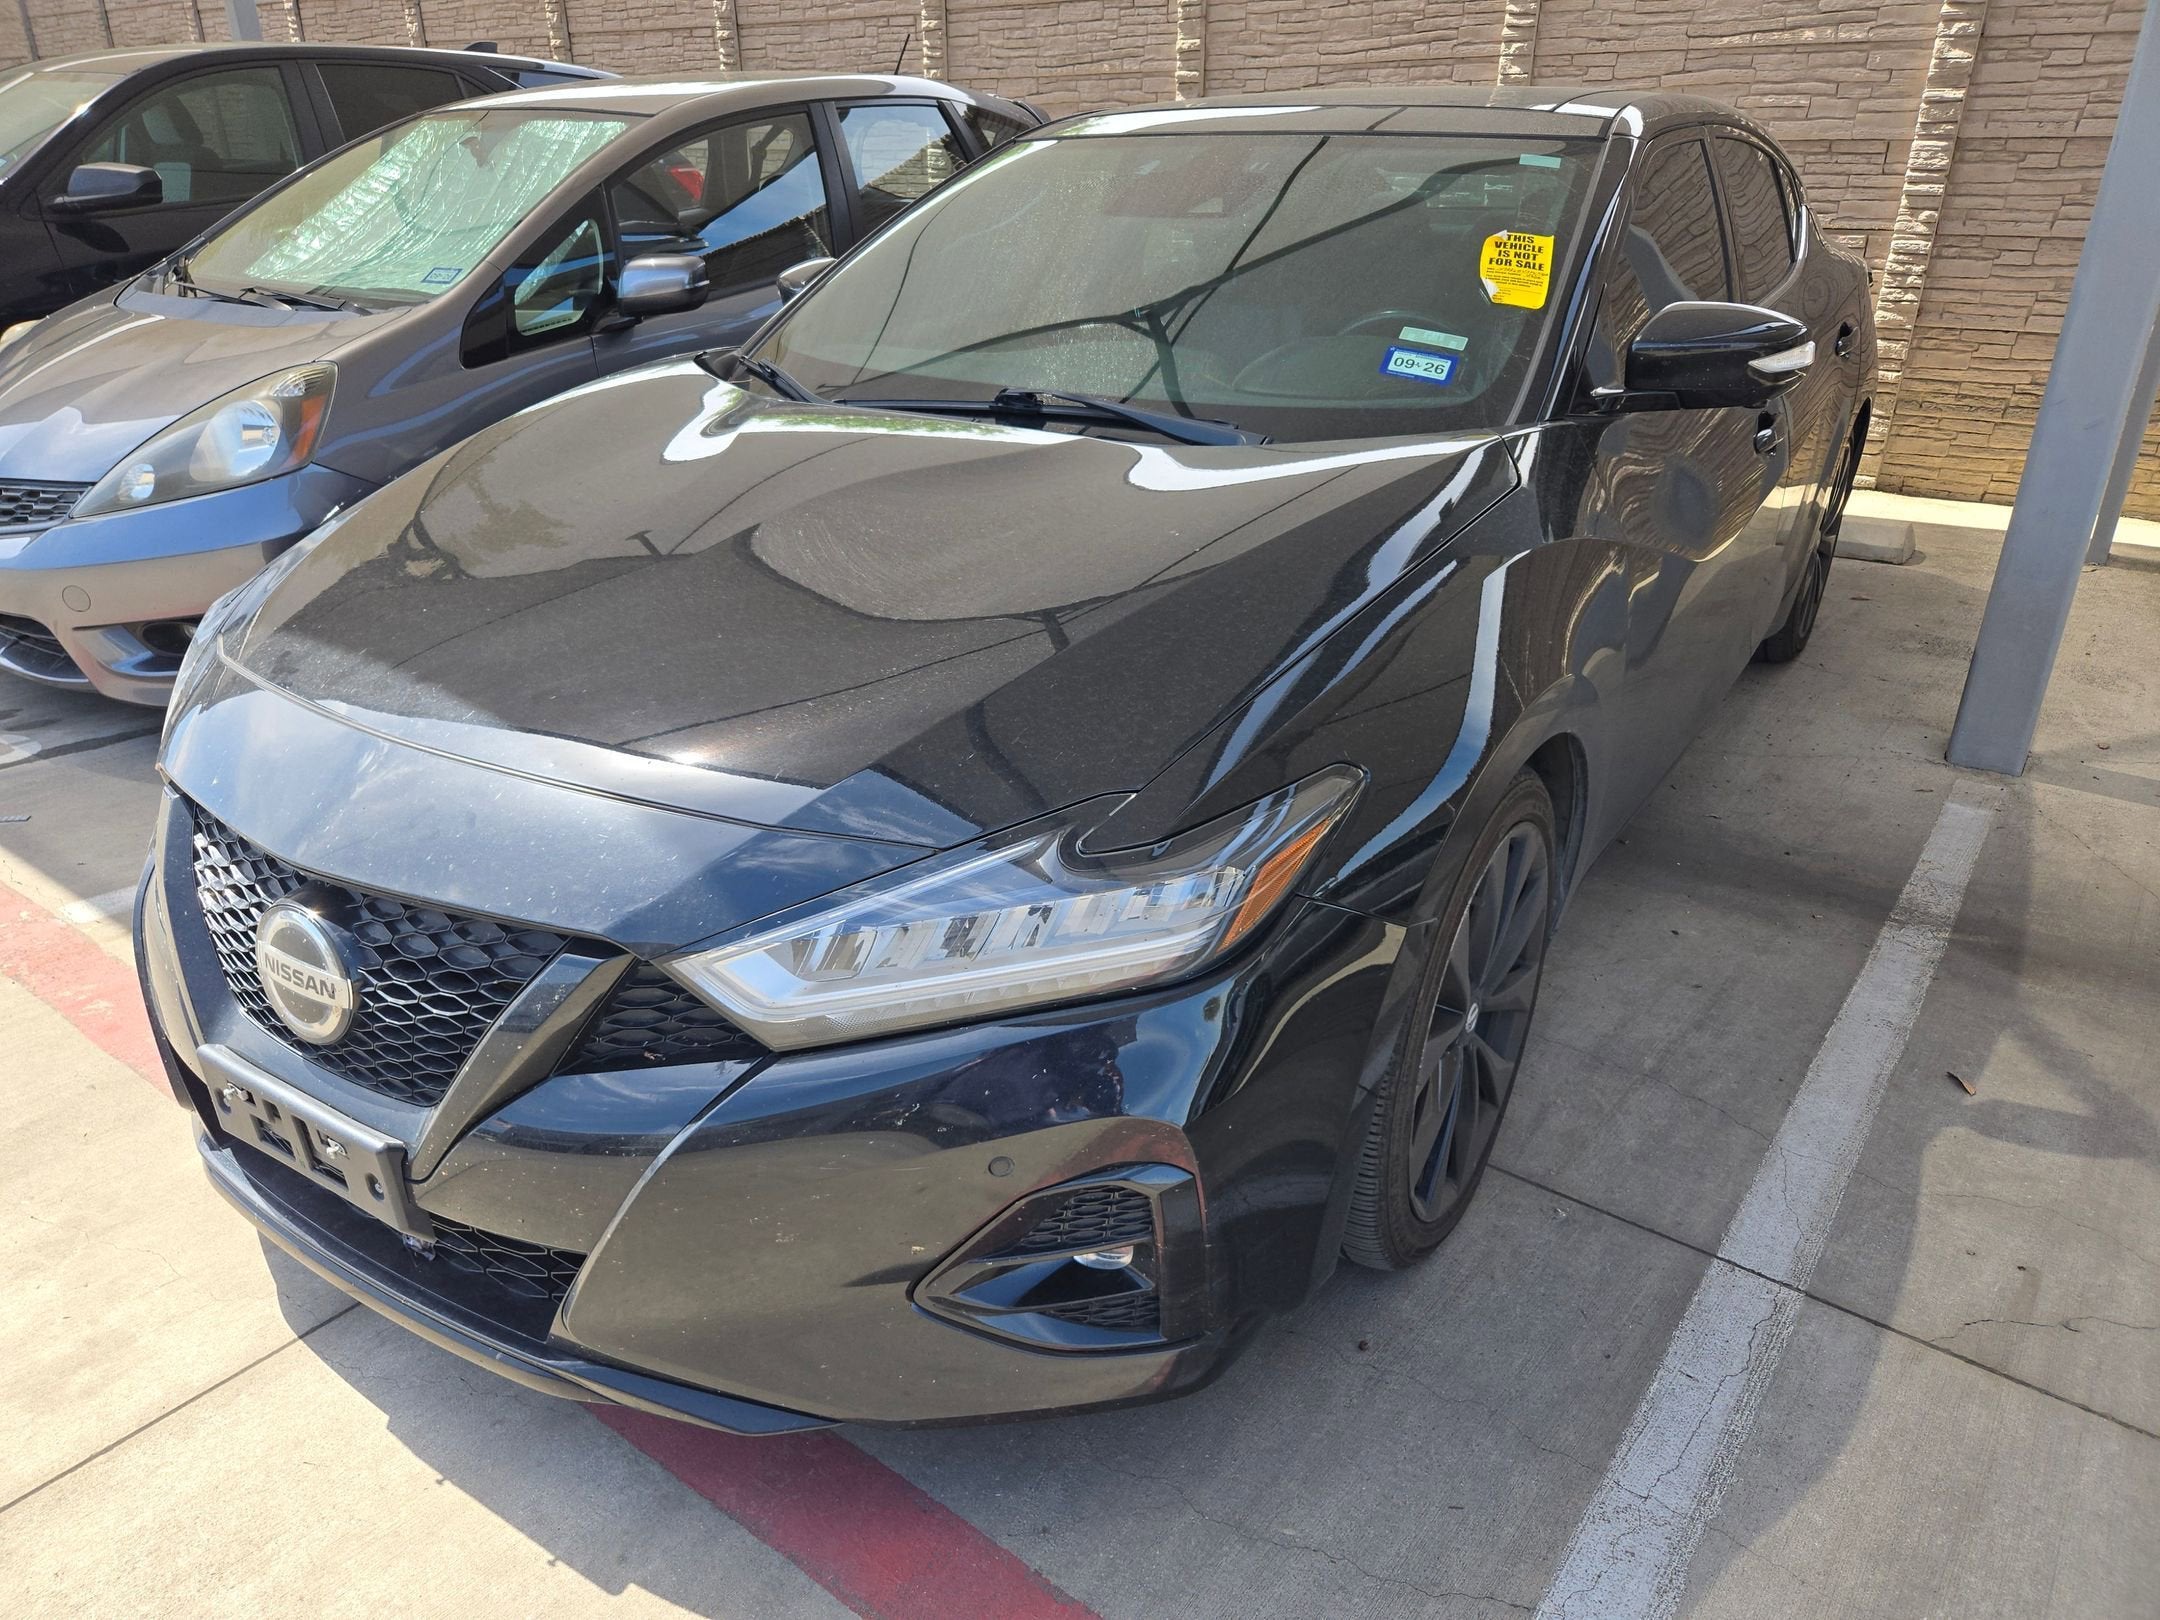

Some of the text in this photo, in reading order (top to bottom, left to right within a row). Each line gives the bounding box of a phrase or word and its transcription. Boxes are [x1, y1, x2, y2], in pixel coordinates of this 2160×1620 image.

[1507, 234, 1534, 243] THIS
[1494, 241, 1544, 254] VEHICLE
[1498, 249, 1538, 261] IS NOT
[1489, 257, 1545, 271] FOR SALE
[1394, 357, 1415, 369] 09
[1423, 362, 1446, 374] 26
[264, 951, 336, 1000] NISSAN
